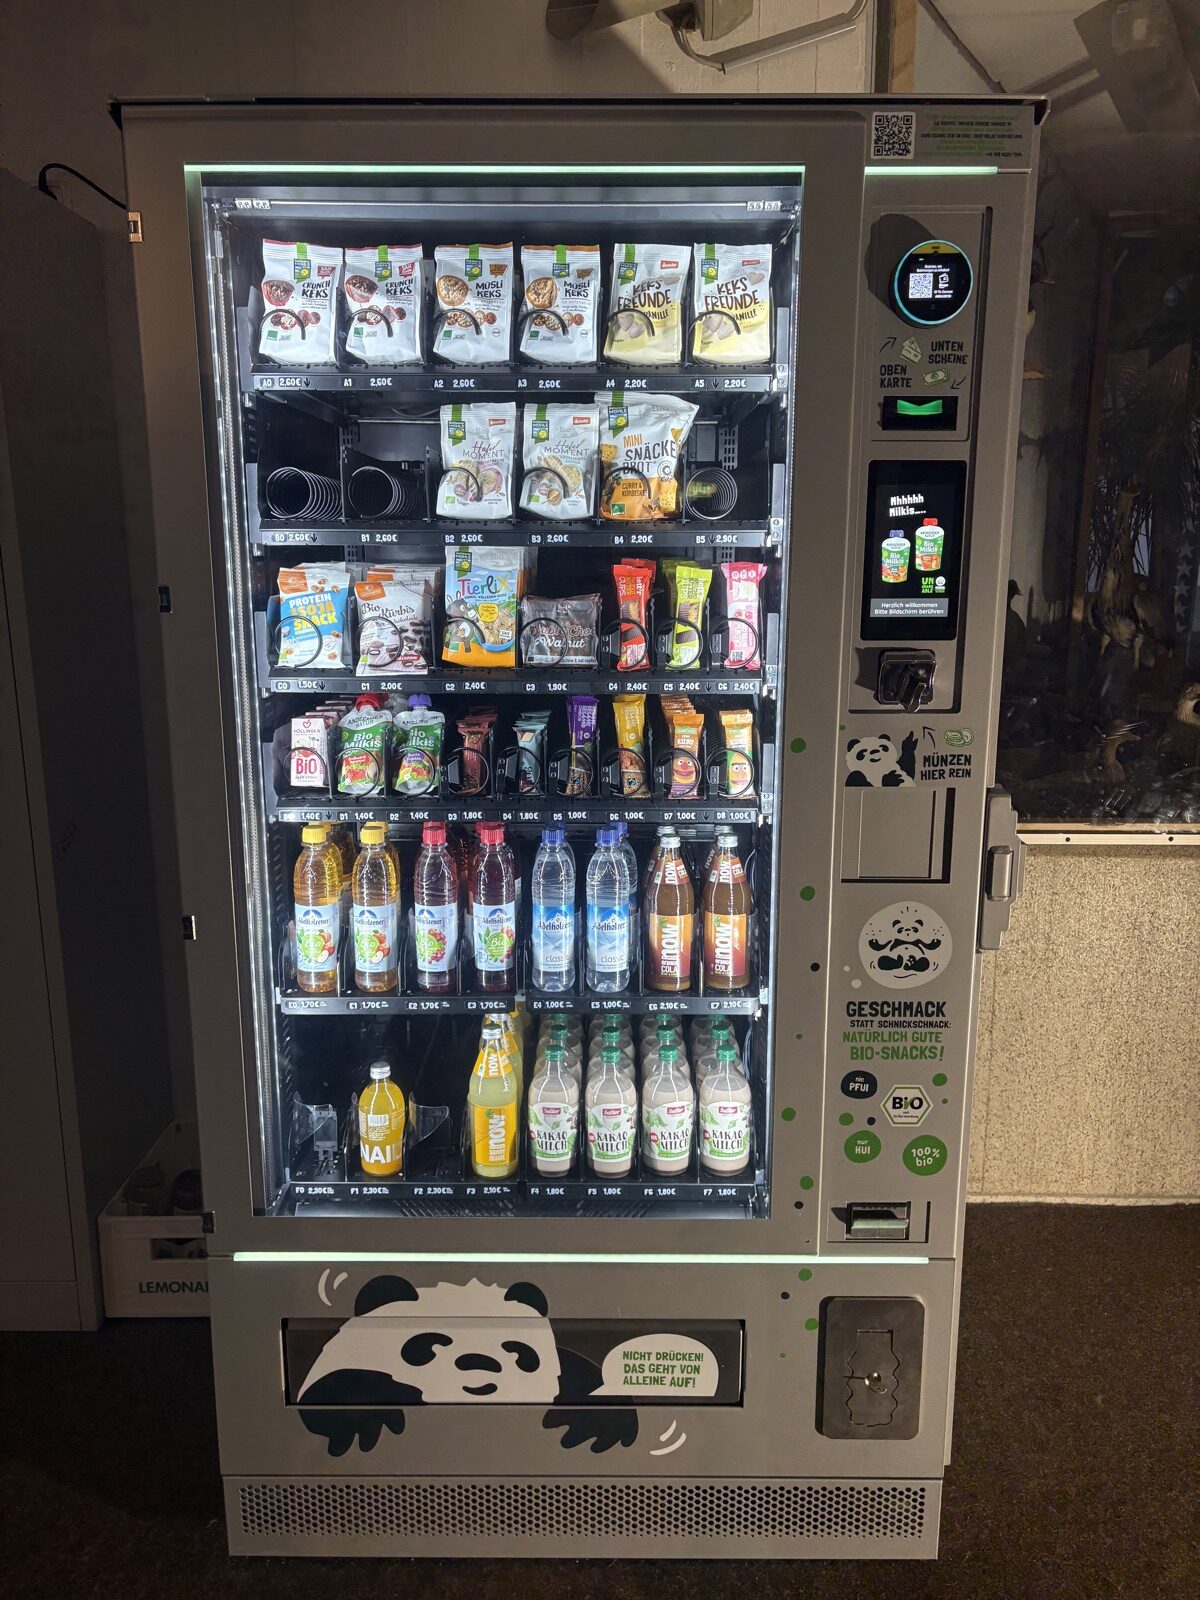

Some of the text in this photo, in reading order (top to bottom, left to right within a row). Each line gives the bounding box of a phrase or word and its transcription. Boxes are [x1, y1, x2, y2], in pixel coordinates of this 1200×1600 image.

[302, 280, 330, 289] CRUNCH
[385, 280, 414, 288] CRUNCH
[633, 280, 662, 295] KEKS
[717, 276, 747, 295] KEKS
[301, 289, 328, 298] KEKS
[386, 286, 412, 295] KEKS
[477, 290, 501, 298] KEKS
[564, 288, 588, 297] KEKS
[618, 289, 671, 311] FREUNDE
[704, 290, 759, 311] FREUNDE
[931, 341, 963, 352] UNTEN
[928, 354, 968, 364] SCHEINE
[880, 365, 907, 375] OBEN
[279, 378, 301, 387] 2,60€
[343, 378, 392, 387] A1 2,60€
[434, 379, 475, 388] A2 2,60€
[518, 379, 560, 388] A3 2,60€
[606, 379, 646, 388] A4 2,20€
[695, 379, 746, 388] A5 2,20€
[880, 378, 912, 388] KARTE
[623, 434, 642, 448] MINI
[544, 447, 589, 456] MOMENT
[624, 440, 676, 461] SNÄCKE
[288, 533, 310, 541] 2,60€
[361, 534, 398, 542] B1 2,60€
[445, 534, 483, 543] B2 2,60€
[531, 534, 569, 543] B3 2,60€
[614, 534, 653, 544] B4 2,20€
[695, 534, 737, 544] B5 2,90€
[289, 593, 331, 608] PROTEIN
[297, 601, 335, 616] SOJA
[361, 603, 415, 618] Bio Kürbis
[297, 681, 317, 689] 1,50€
[361, 682, 402, 691] C1 2,00€
[445, 681, 485, 691] C2 2,40€
[526, 682, 567, 691] C3 1,90€
[608, 682, 647, 691] C4 2,40€
[664, 682, 700, 691] C5 2,40€
[718, 682, 755, 691] C6 2,40€
[354, 732, 372, 741] Bio
[344, 741, 382, 749] Milkis
[923, 752, 971, 767] MÜNZEN
[921, 768, 971, 780] HIER REIN
[300, 812, 320, 820] 1,40€
[339, 812, 374, 820] D1 1,40€
[389, 811, 429, 820] D2 1,40€
[448, 811, 482, 821] D3 1,80€
[503, 812, 538, 820] D4 1,80€
[553, 811, 587, 821] D5 1,00€
[610, 811, 644, 821] D6 1,00€
[664, 812, 696, 820] D7 1,00€
[717, 811, 749, 820] D8 1,00€
[665, 861, 676, 884] now
[720, 861, 731, 883] now
[662, 923, 679, 961] now
[715, 922, 733, 961] now
[661, 965, 678, 973] COLA
[362, 1001, 381, 1009] 1,70€
[409, 1001, 439, 1010] E2 1,70€
[846, 1001, 947, 1017] GESCHMACK
[850, 1020, 951, 1028] STATT SCHNICKSCHNACK:
[843, 1029, 943, 1043] NATÜRLICH GUTE
[851, 1046, 944, 1061] BIO-SNACKS!
[489, 1054, 499, 1076] now
[849, 1083, 869, 1092] PFUI
[489, 1114, 506, 1150] now
[537, 1130, 567, 1140] KAKAO
[597, 1131, 627, 1142] KAKAO
[661, 1128, 689, 1141] KAKAO
[712, 1130, 743, 1140] KAKAO
[855, 1146, 871, 1154] HUI
[916, 1156, 933, 1167] bio
[623, 1350, 704, 1361] NICHT DRÜCKEN!
[624, 1364, 700, 1374] DAS GEHT VON
[623, 1376, 696, 1387] ALLEINE AUF!
